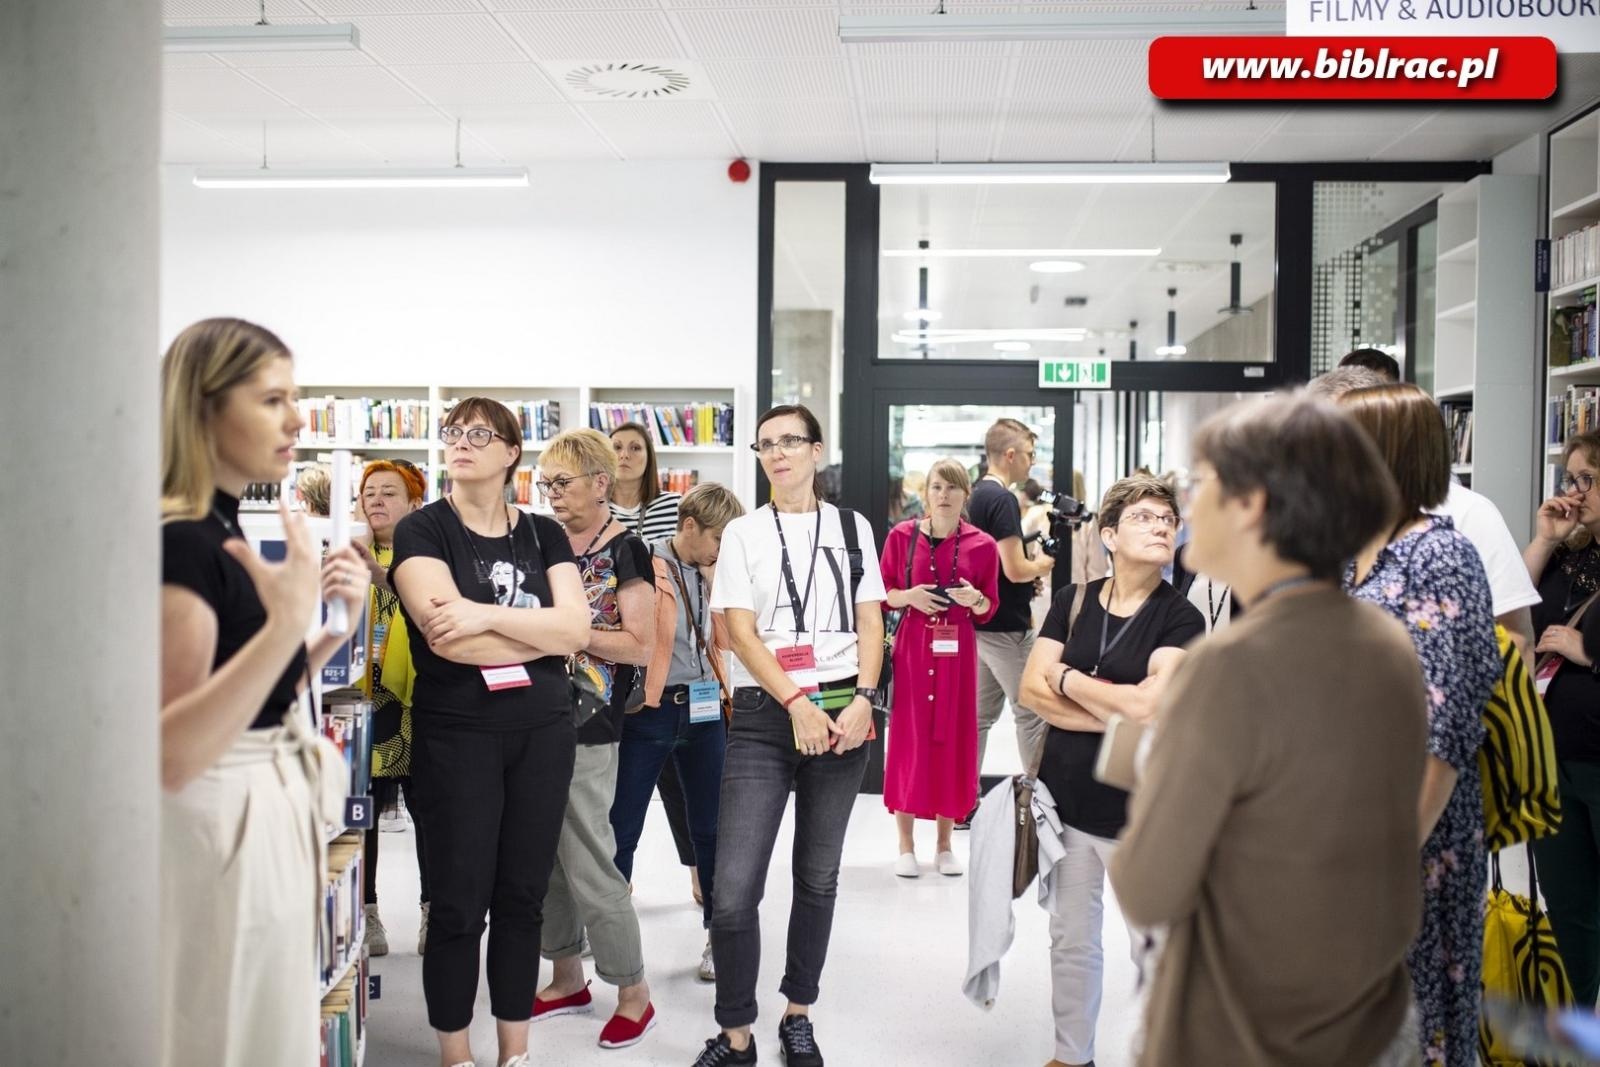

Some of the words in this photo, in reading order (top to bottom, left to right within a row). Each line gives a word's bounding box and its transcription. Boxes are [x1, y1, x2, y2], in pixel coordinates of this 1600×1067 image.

[1310, 0, 1387, 22] FILMY
[1398, 0, 1417, 20] &
[1426, 0, 1600, 20] AUDIOBOOK
[352, 804, 365, 821] B
